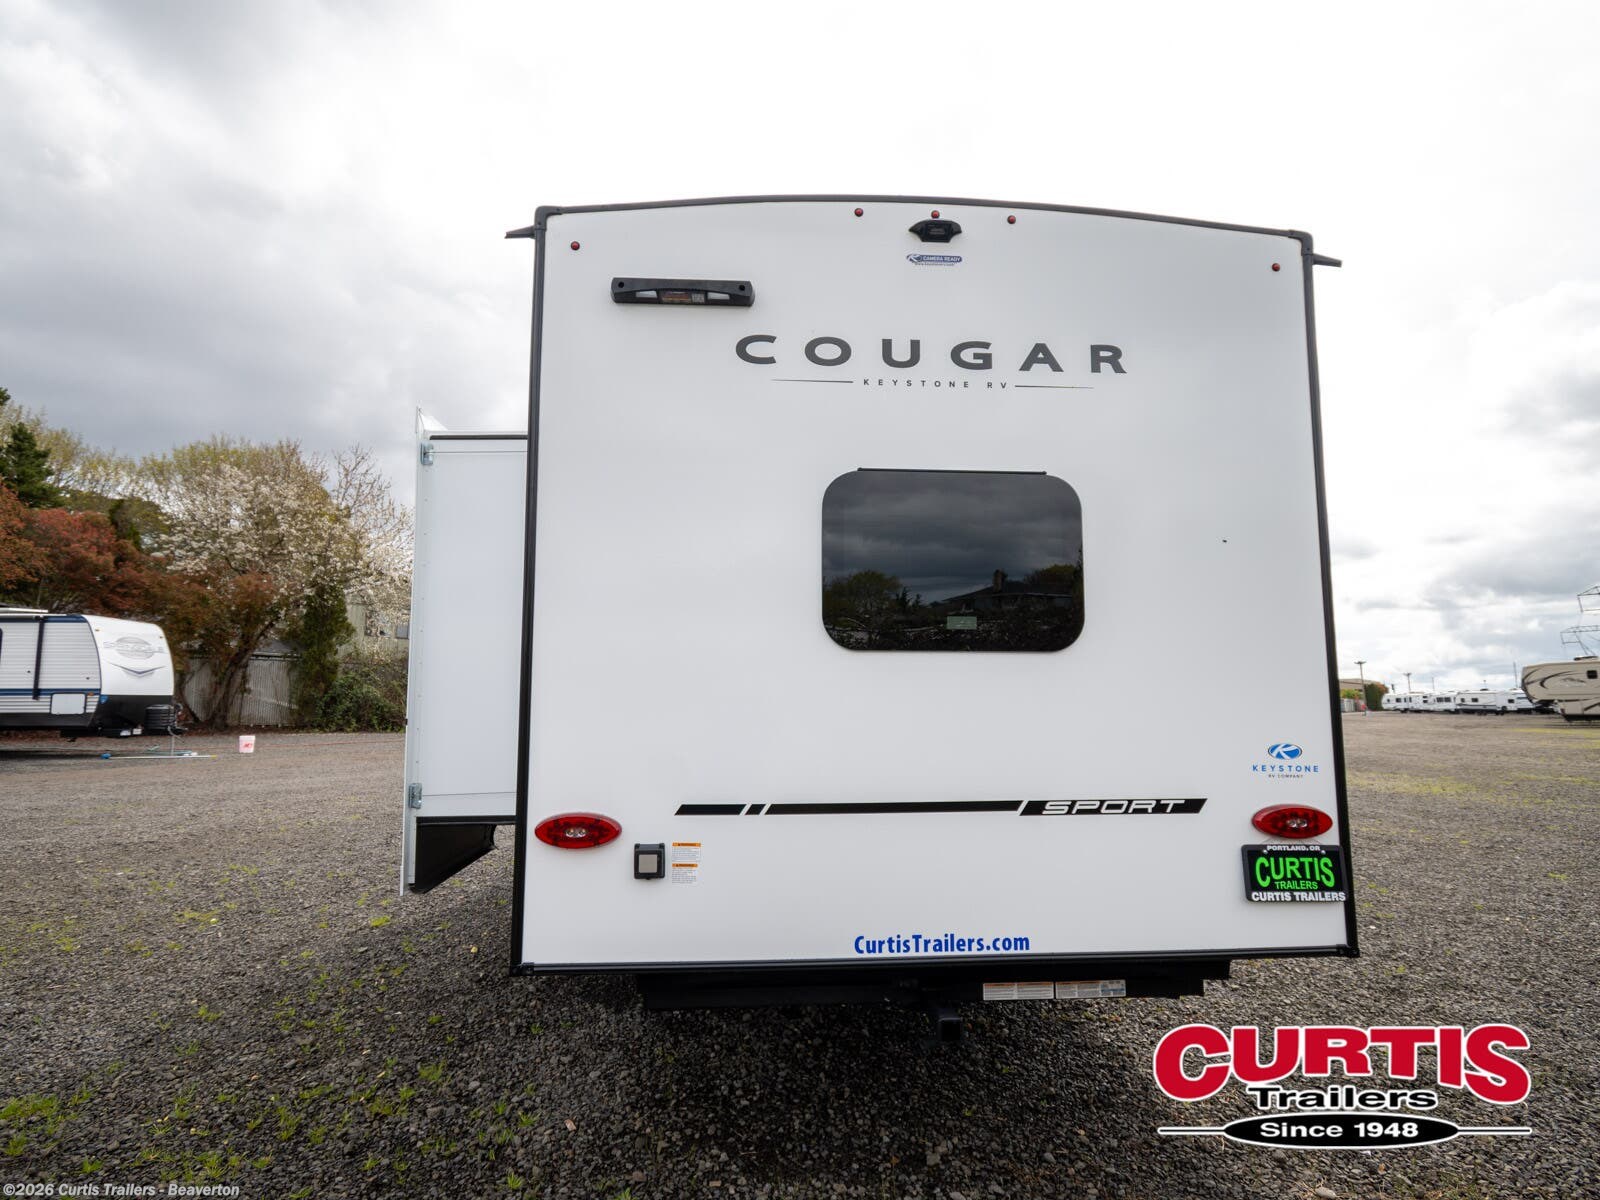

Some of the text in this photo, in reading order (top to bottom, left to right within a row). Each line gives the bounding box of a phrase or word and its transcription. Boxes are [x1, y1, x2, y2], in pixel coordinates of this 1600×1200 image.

[736, 335, 1128, 374] COUGAR
[863, 378, 1007, 389] KEYSTONE RV
[1252, 764, 1319, 773] KEYSTONE
[1041, 799, 1186, 815] SPORT
[1255, 857, 1335, 888] CURTIS
[1274, 880, 1319, 890] TRAILERS
[1251, 891, 1346, 902] CURTIS TRAILERS
[854, 933, 1031, 955] CurtisTrailers.com
